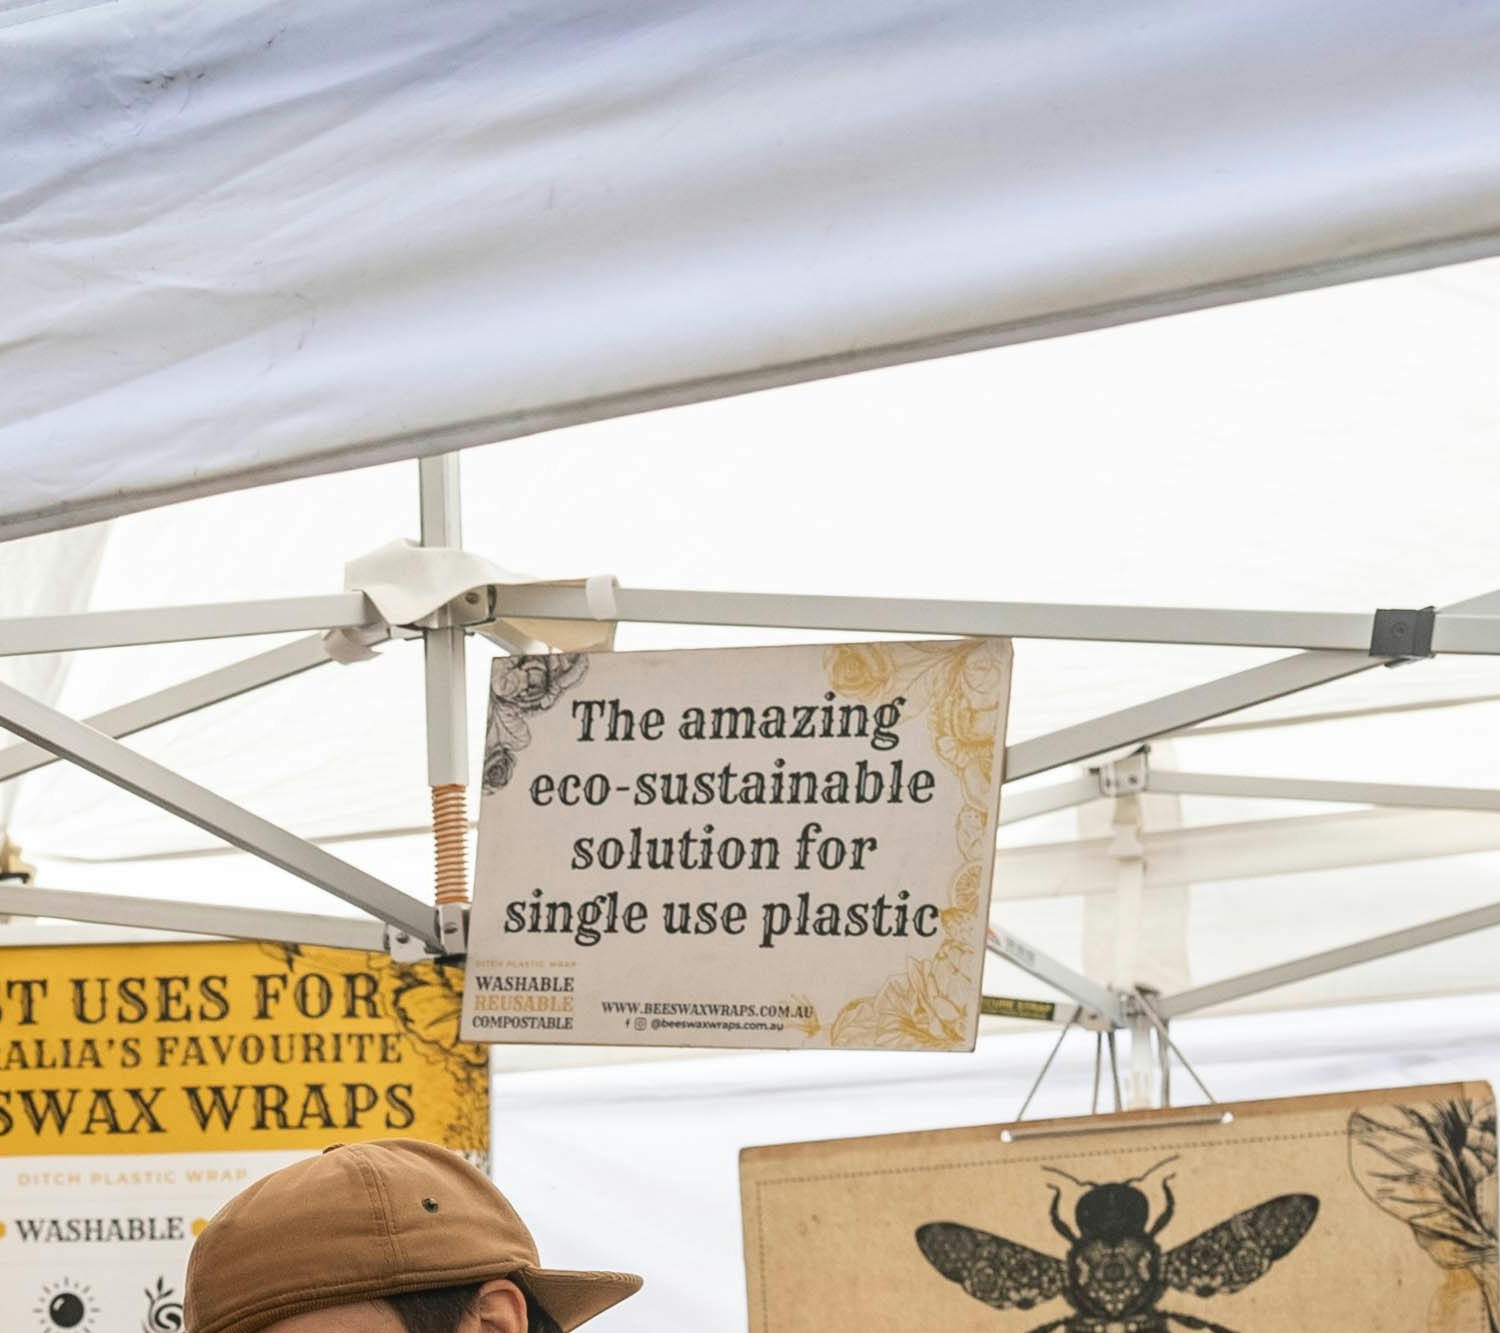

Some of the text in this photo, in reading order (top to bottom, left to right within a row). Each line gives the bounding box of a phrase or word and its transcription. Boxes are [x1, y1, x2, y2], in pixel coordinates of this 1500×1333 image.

[572, 692, 906, 751] The amazing
[529, 759, 936, 807] eco-sustainable
[571, 821, 879, 871] solution for
[504, 888, 940, 948] single use plastic
[71, 973, 237, 1027] USES
[256, 970, 380, 1022] FOR
[476, 976, 574, 992] WASHABLE
[474, 995, 573, 1012] REUSABLE
[602, 1001, 813, 1018] WWW.BEESWAXWRAPS.COM.AU
[472, 1016, 573, 1030] COMPOSTABLE
[651, 1019, 784, 1032] @beeswaxwraps.com.au
[156, 1031, 403, 1069] FAVOURITE
[184, 1081, 417, 1133] WRAPS
[17, 1167, 249, 1188] DITCH PLASTIC WRAP
[15, 1216, 186, 1245] WASHABLE
